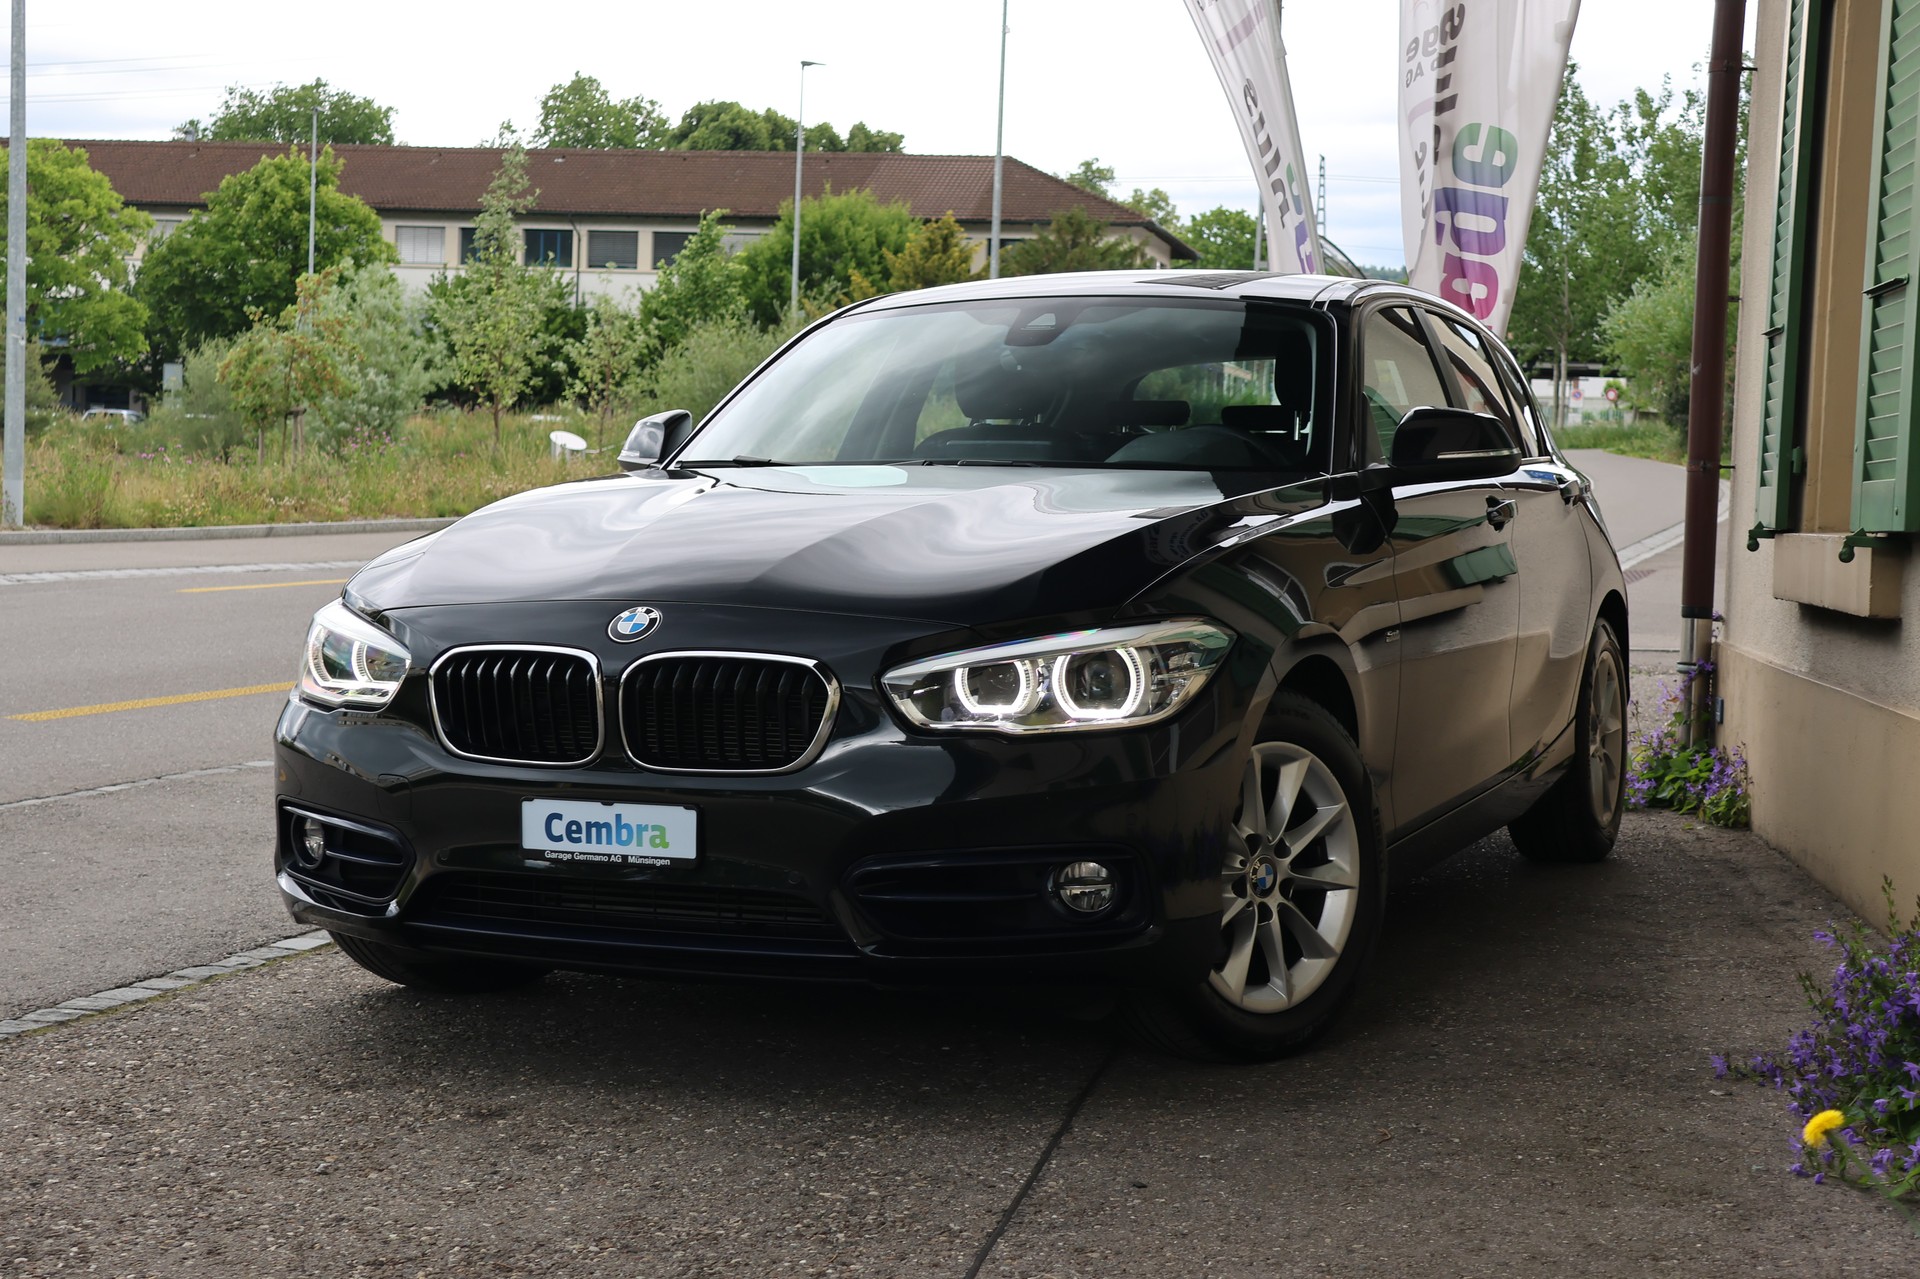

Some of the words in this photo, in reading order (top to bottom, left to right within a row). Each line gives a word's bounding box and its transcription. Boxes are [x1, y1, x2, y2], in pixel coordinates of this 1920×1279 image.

[544, 812, 670, 849] Cembra
[544, 851, 572, 860] Garage
[573, 852, 608, 862] Germano
[627, 855, 671, 866] Münsingen
